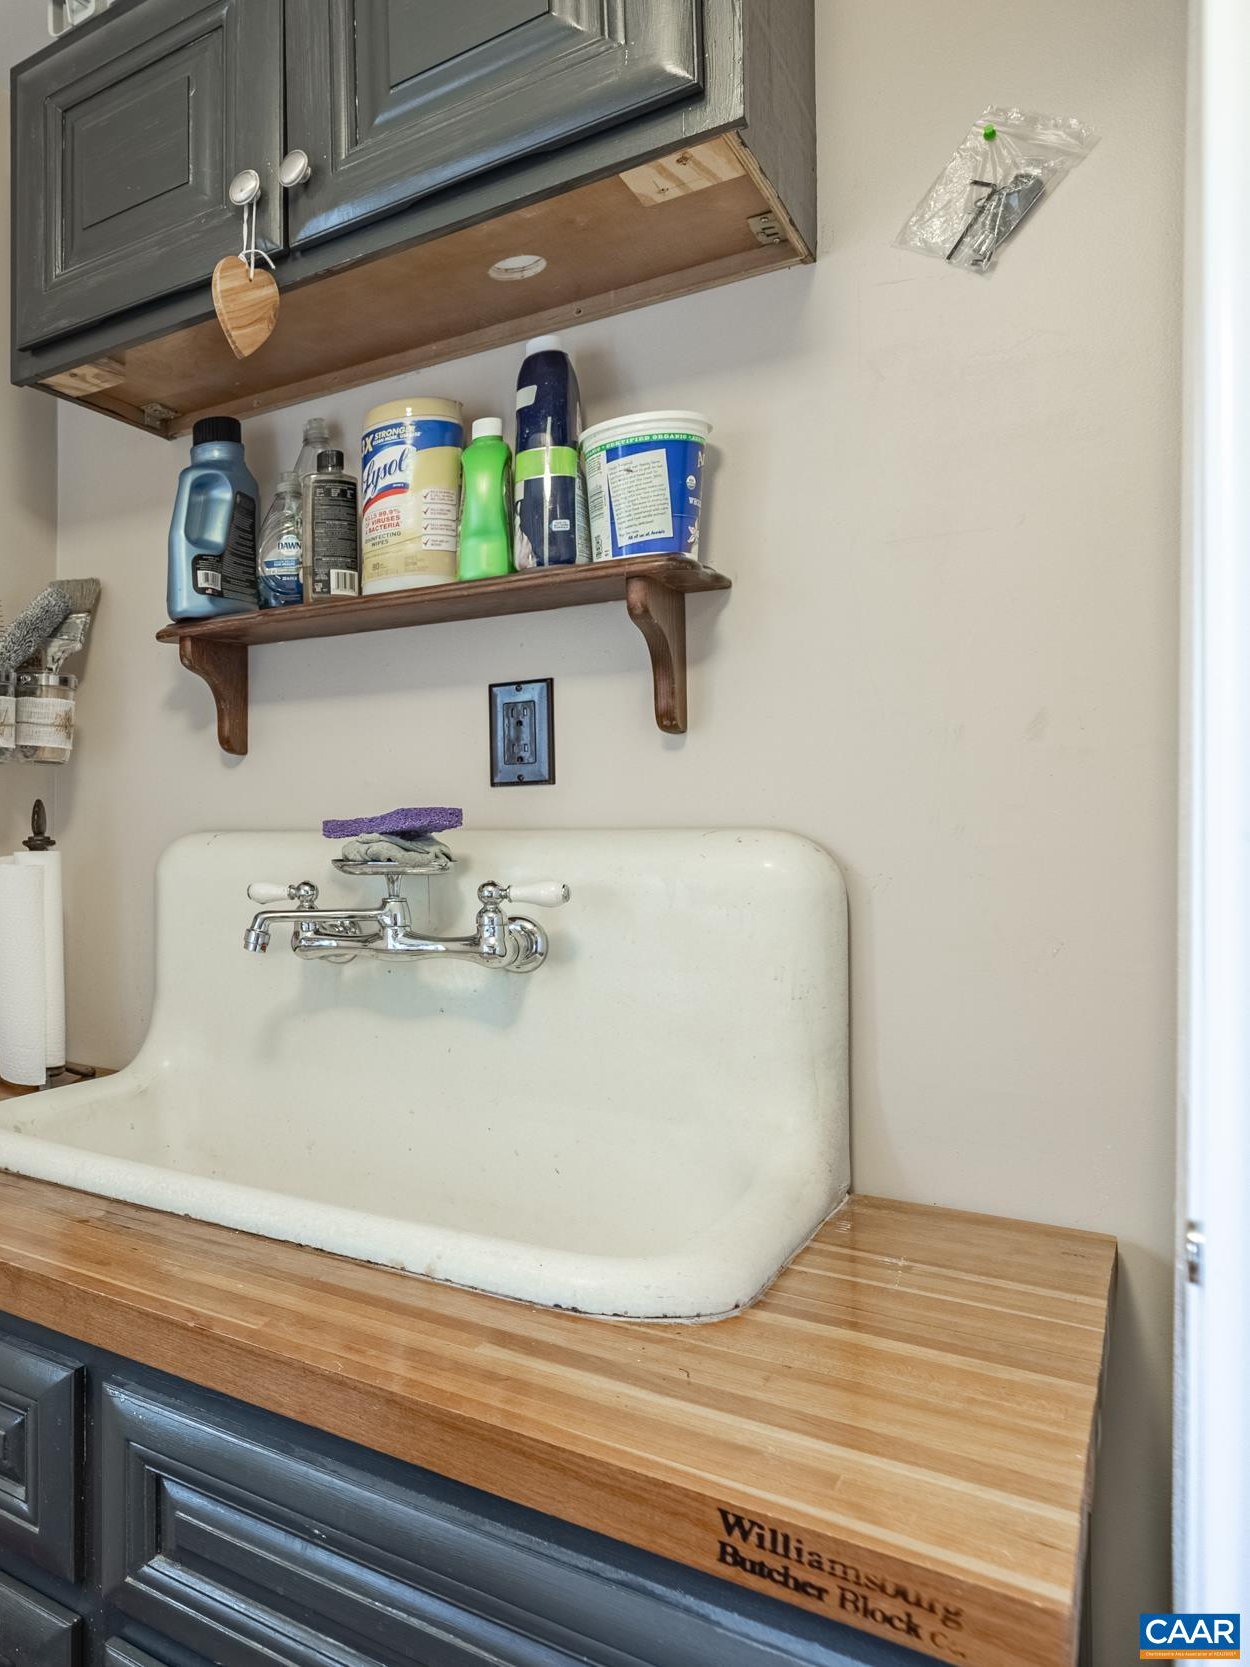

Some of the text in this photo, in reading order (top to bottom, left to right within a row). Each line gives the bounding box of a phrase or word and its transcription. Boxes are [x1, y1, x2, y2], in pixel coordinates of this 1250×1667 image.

[374, 426, 416, 441] STRONGER
[606, 435, 650, 448] CERTIFIED
[362, 447, 410, 495] Lysol
[378, 509, 400, 517] 99.9%
[371, 514, 400, 526] VIRUSES
[368, 521, 400, 533] BACTERIA
[277, 542, 302, 550] DAWN
[371, 539, 389, 547] WIPES
[717, 1540, 829, 1601] Butcher
[837, 1584, 923, 1641] Block
